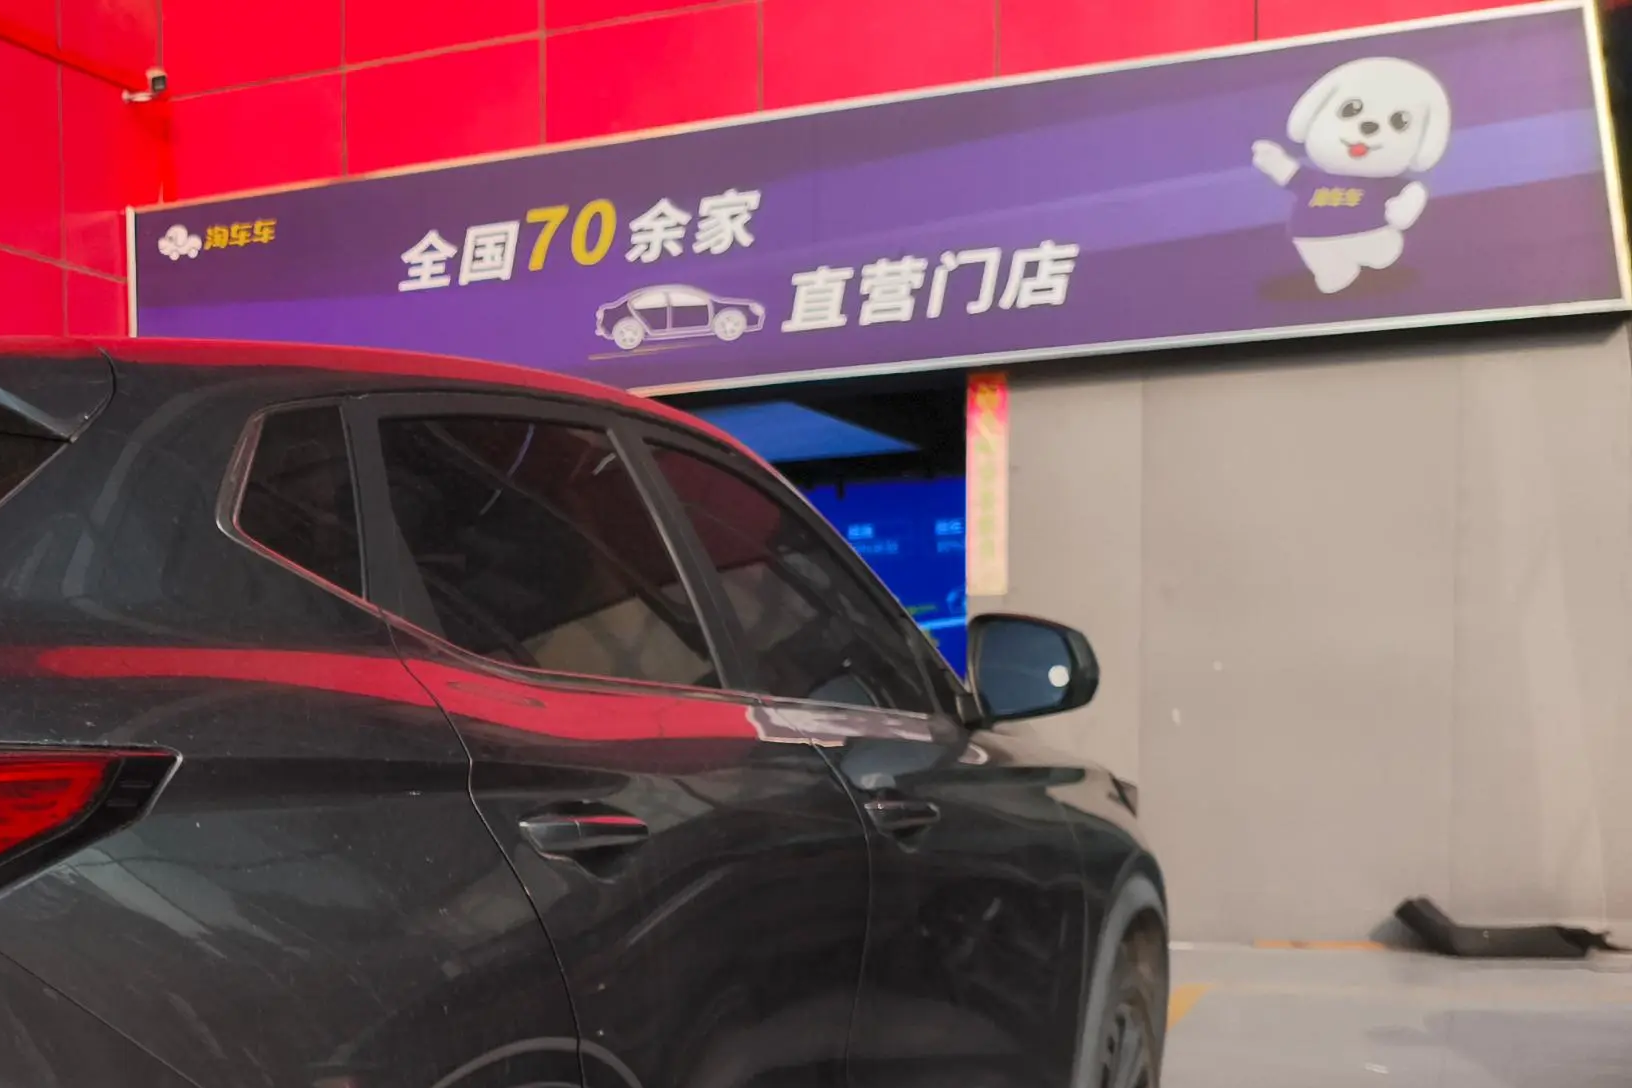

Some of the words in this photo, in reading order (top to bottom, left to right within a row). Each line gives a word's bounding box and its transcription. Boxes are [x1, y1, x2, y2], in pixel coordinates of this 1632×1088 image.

[203, 218, 278, 251] 淘车车
[397, 187, 762, 293] 全国70余家
[780, 238, 1081, 333] 直营门店
